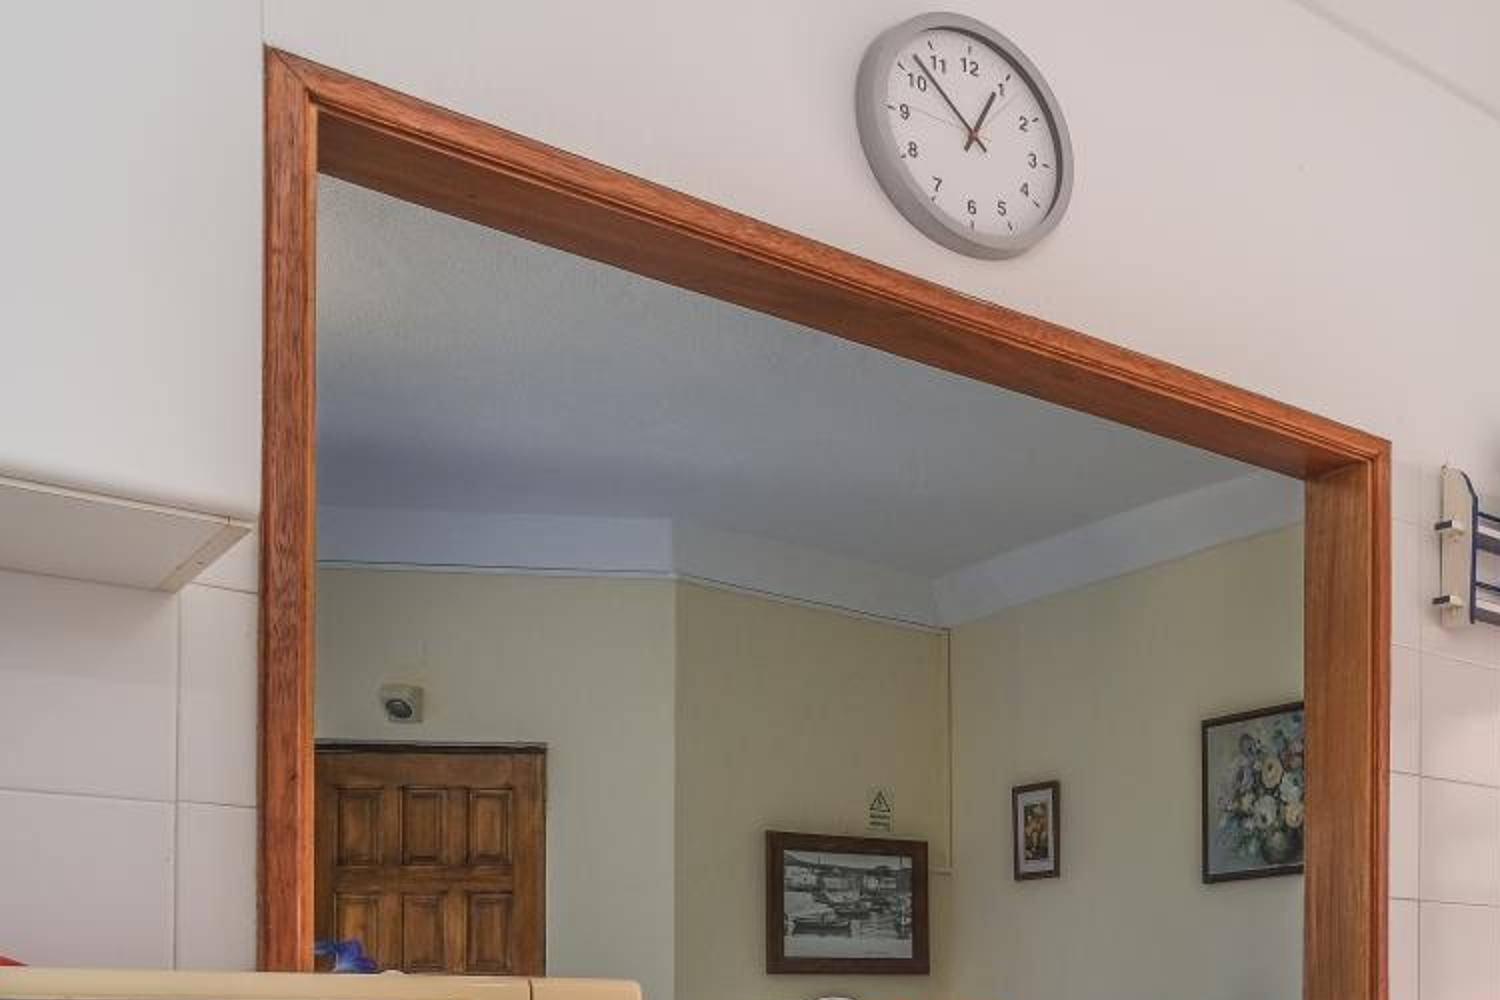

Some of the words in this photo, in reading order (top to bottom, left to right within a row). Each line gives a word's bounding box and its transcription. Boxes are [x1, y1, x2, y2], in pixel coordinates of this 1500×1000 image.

[930, 56, 946, 74] 11
[960, 58, 980, 77] 12
[908, 73, 927, 92] 10
[900, 104, 910, 120] 9
[1019, 116, 1029, 132] 2
[908, 142, 918, 158] 8
[1028, 154, 1037, 169] 3
[933, 177, 943, 192] 7
[1021, 183, 1029, 197] 4
[967, 200, 977, 215] 6
[998, 201, 1007, 216] 5
